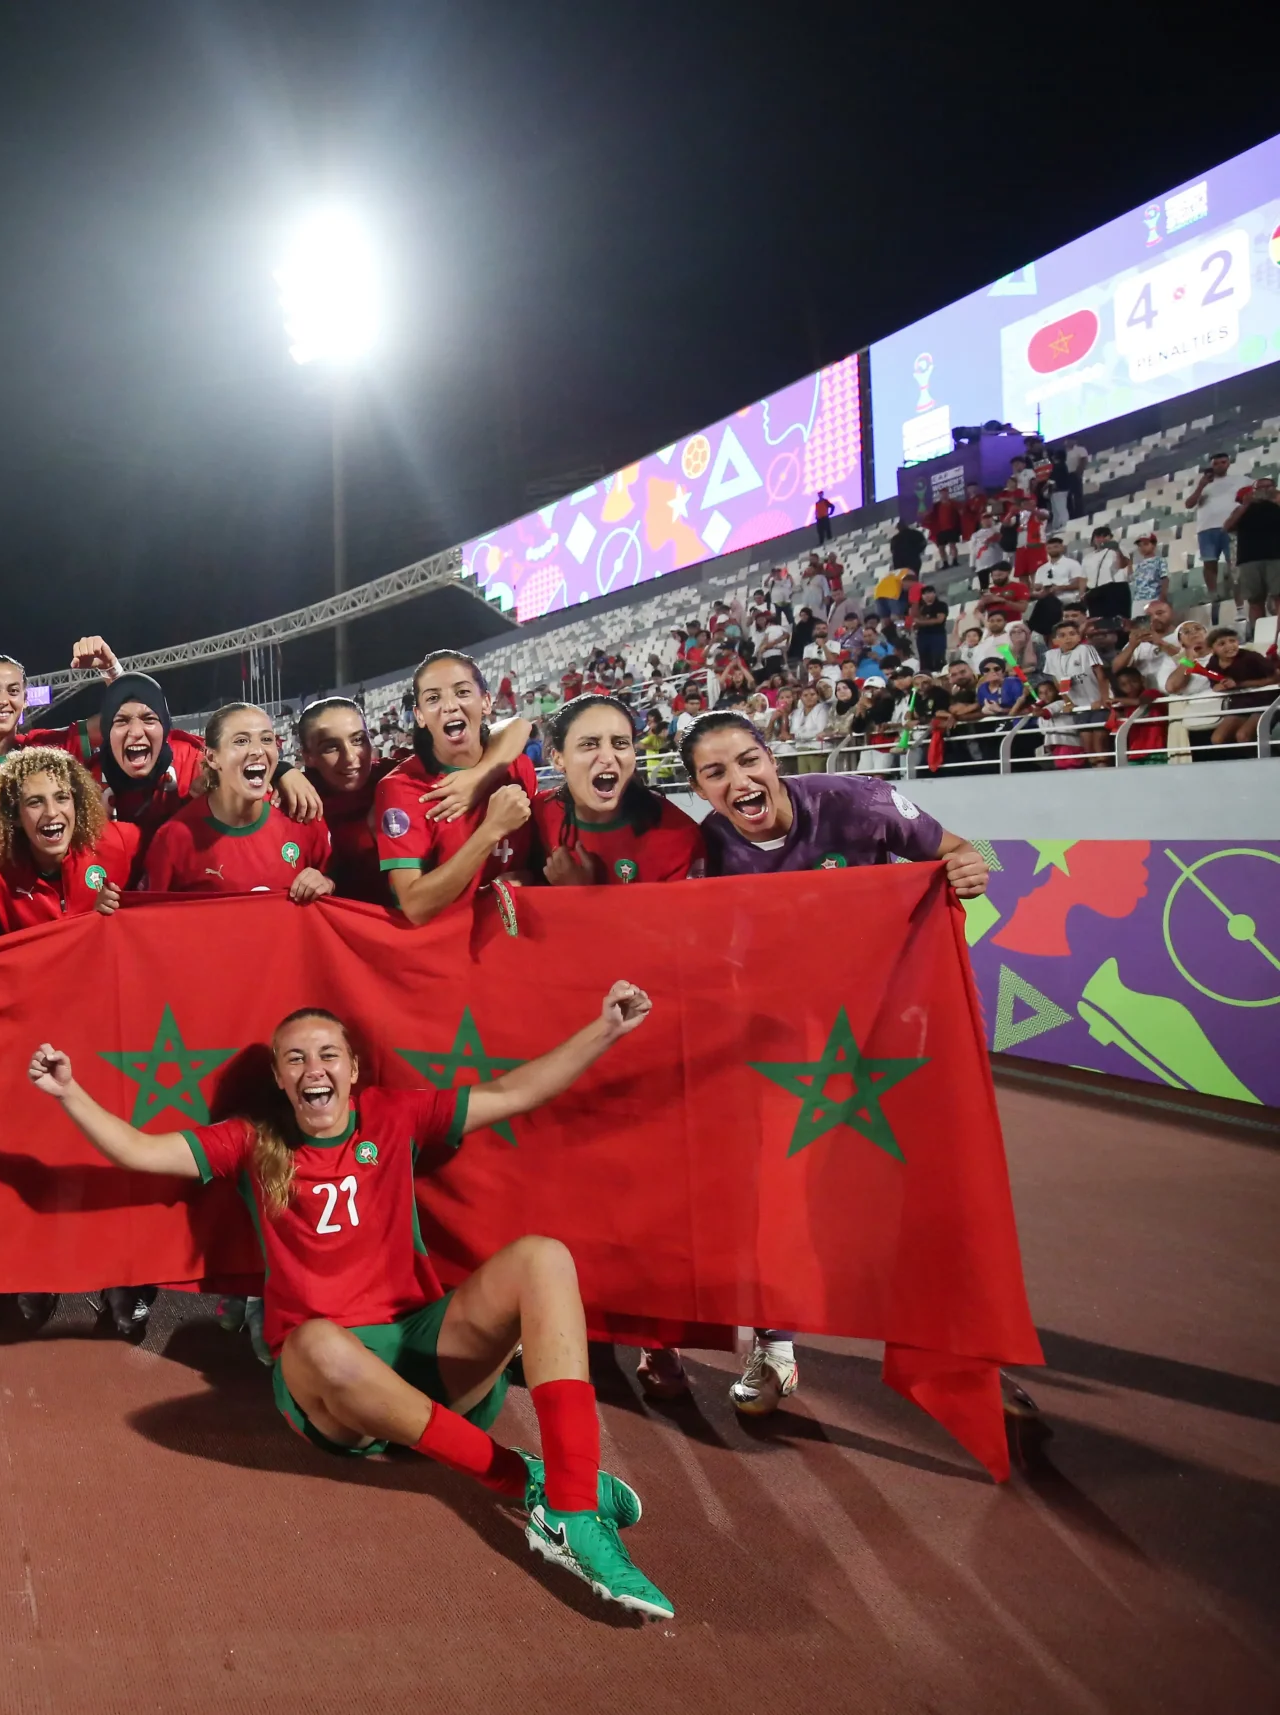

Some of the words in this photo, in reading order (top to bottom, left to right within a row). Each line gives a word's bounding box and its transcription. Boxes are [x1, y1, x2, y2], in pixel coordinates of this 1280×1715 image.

[1126, 282, 1158, 330] 4
[1200, 250, 1234, 307] 2
[1137, 325, 1229, 368] PENALTIES
[312, 1175, 360, 1234] 21
